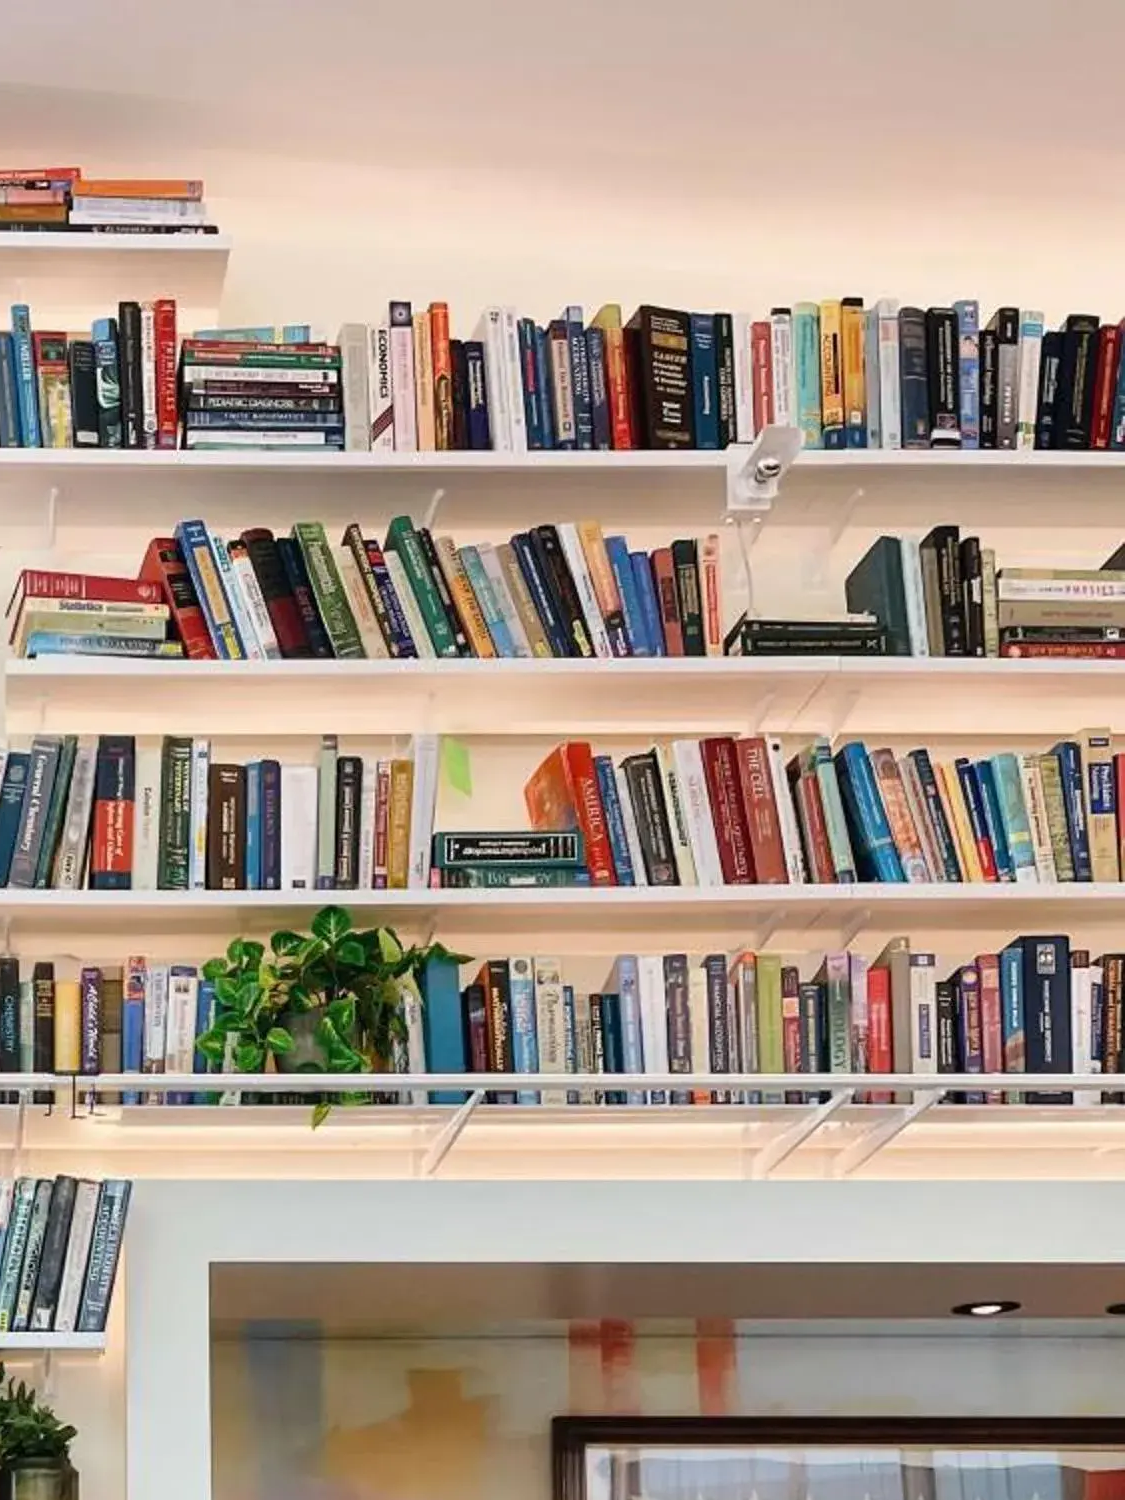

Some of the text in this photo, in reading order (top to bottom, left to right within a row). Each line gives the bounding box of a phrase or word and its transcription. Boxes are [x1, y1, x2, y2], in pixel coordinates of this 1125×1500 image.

[377, 329, 390, 399] ECONOMICS
[823, 334, 833, 397] ACCOUNTING
[746, 749, 759, 770] THE
[22, 755, 47, 852] General Chemistry
[582, 778, 603, 841] AMERICA
[3, 995, 15, 1053] CHEMISTRY
